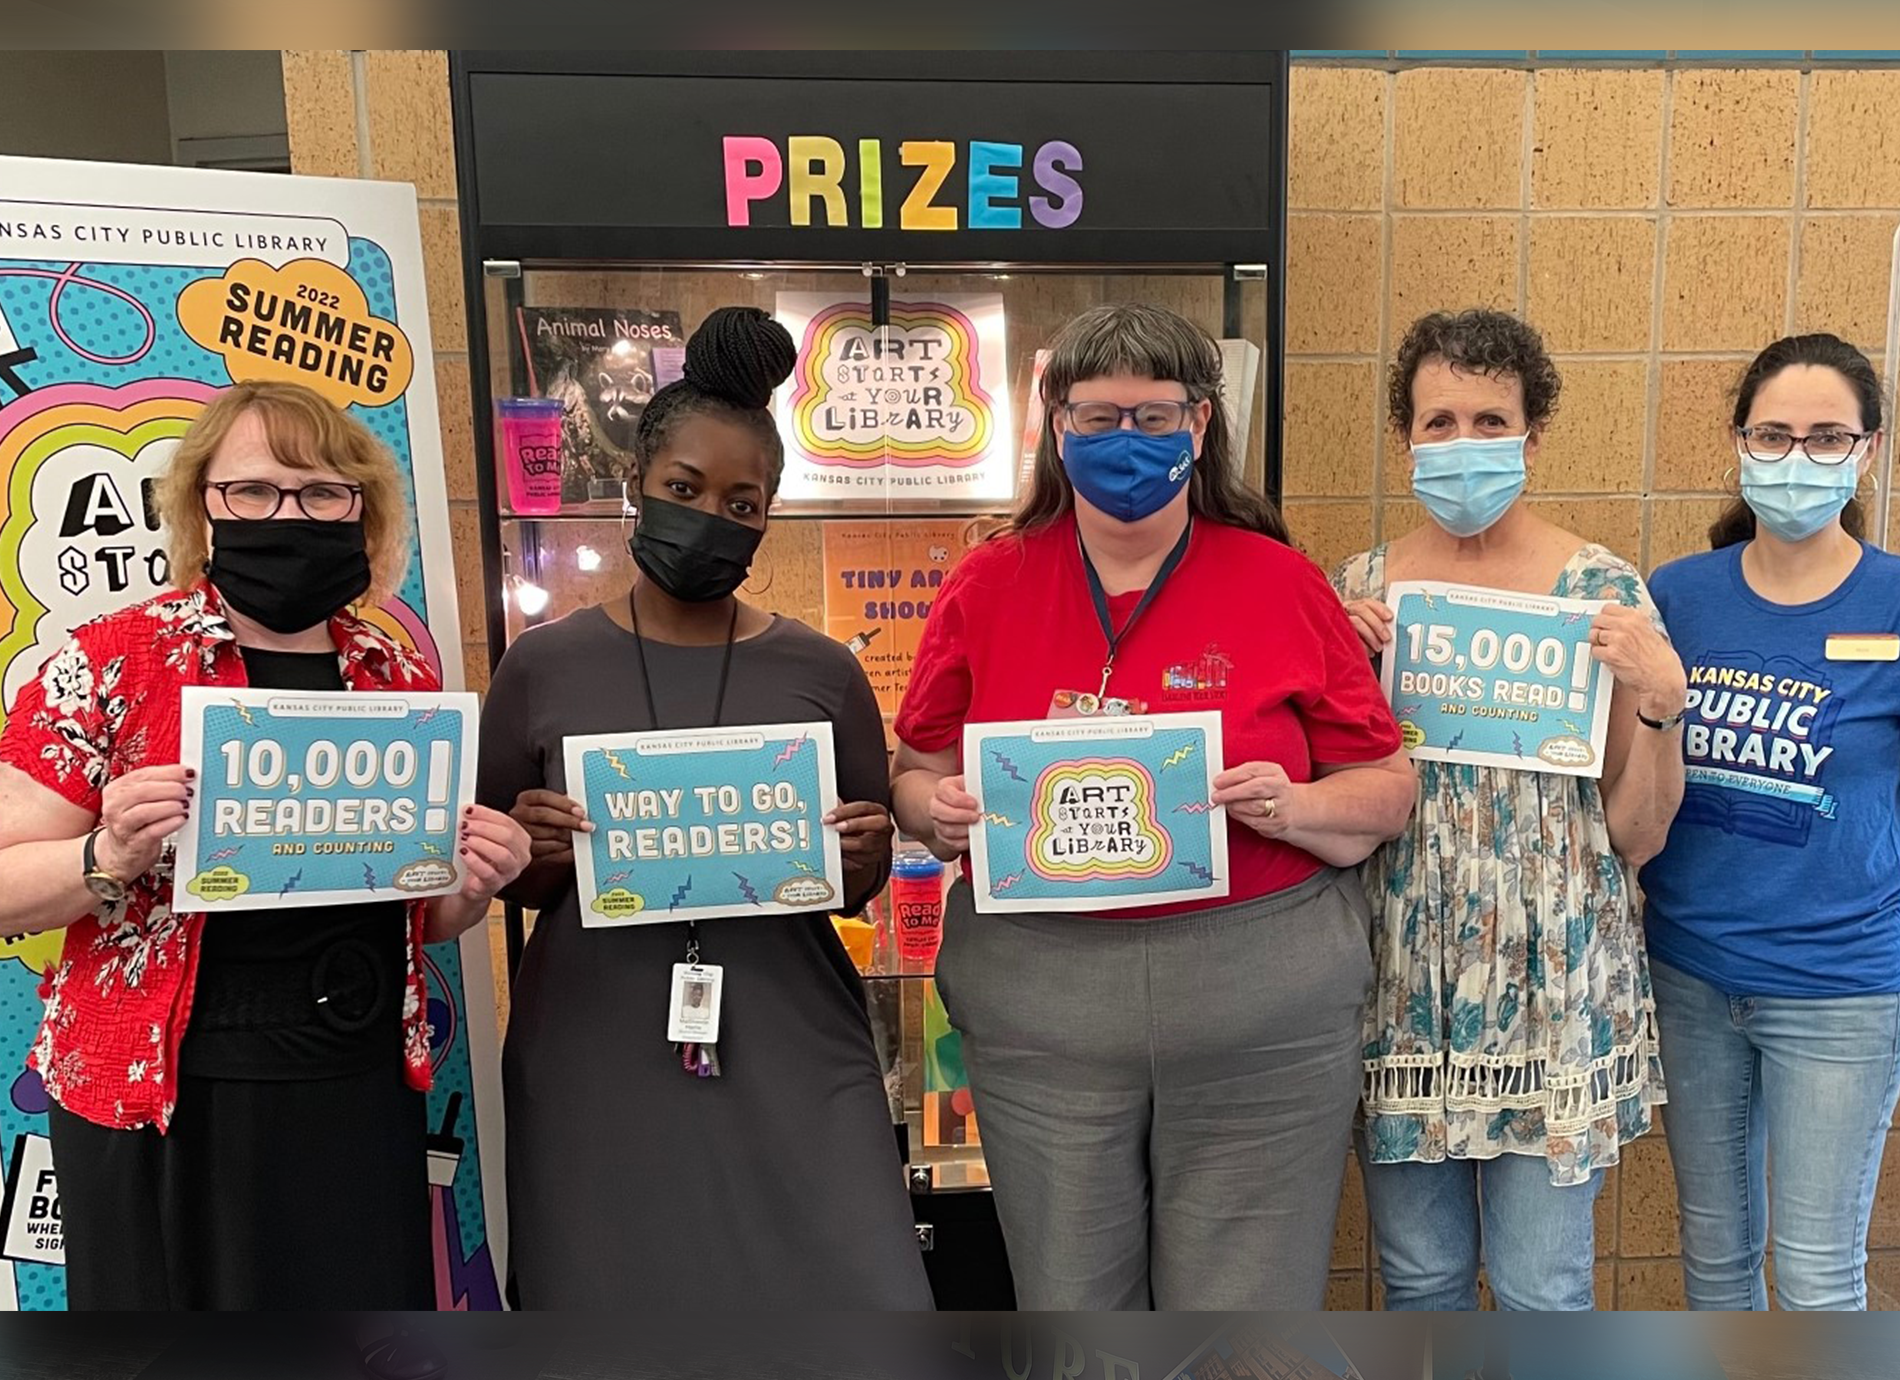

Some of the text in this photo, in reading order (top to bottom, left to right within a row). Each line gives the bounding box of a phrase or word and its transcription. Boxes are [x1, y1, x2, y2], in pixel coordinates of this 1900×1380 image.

[722, 135, 1084, 230] PRIZES
[0, 222, 327, 252] NSAS CITY PUBLIC LIBRARY
[296, 284, 340, 310] 2022
[226, 282, 396, 364] SUMMER
[537, 317, 672, 338] Animal Noses
[219, 315, 389, 394] READING
[839, 336, 942, 361] ART
[803, 472, 986, 486] KANSAS CITY PUBLIC LIBRARY
[841, 569, 949, 589] TINY AR
[865, 653, 902, 662] created
[1407, 622, 1566, 678] 15,000
[1400, 671, 1565, 710] BOOKS READ
[1689, 666, 1831, 704] KANSAS CITY
[1441, 703, 1539, 722] AND COUNTING
[1685, 689, 1818, 738] PUBLIC
[220, 738, 417, 793] 10,000
[1687, 724, 1834, 779] BRARY
[1060, 785, 1130, 805] ART
[1685, 768, 1791, 795] PEN TO EVERYONE
[604, 781, 807, 820] WAY TO GO,
[214, 798, 417, 837] READERS
[272, 840, 395, 856] AND COUNTING
[607, 819, 810, 860] READERS!
[900, 900, 941, 918] Read
[27, 1222, 63, 1234] WHE
[35, 1238, 64, 1250] SIG
